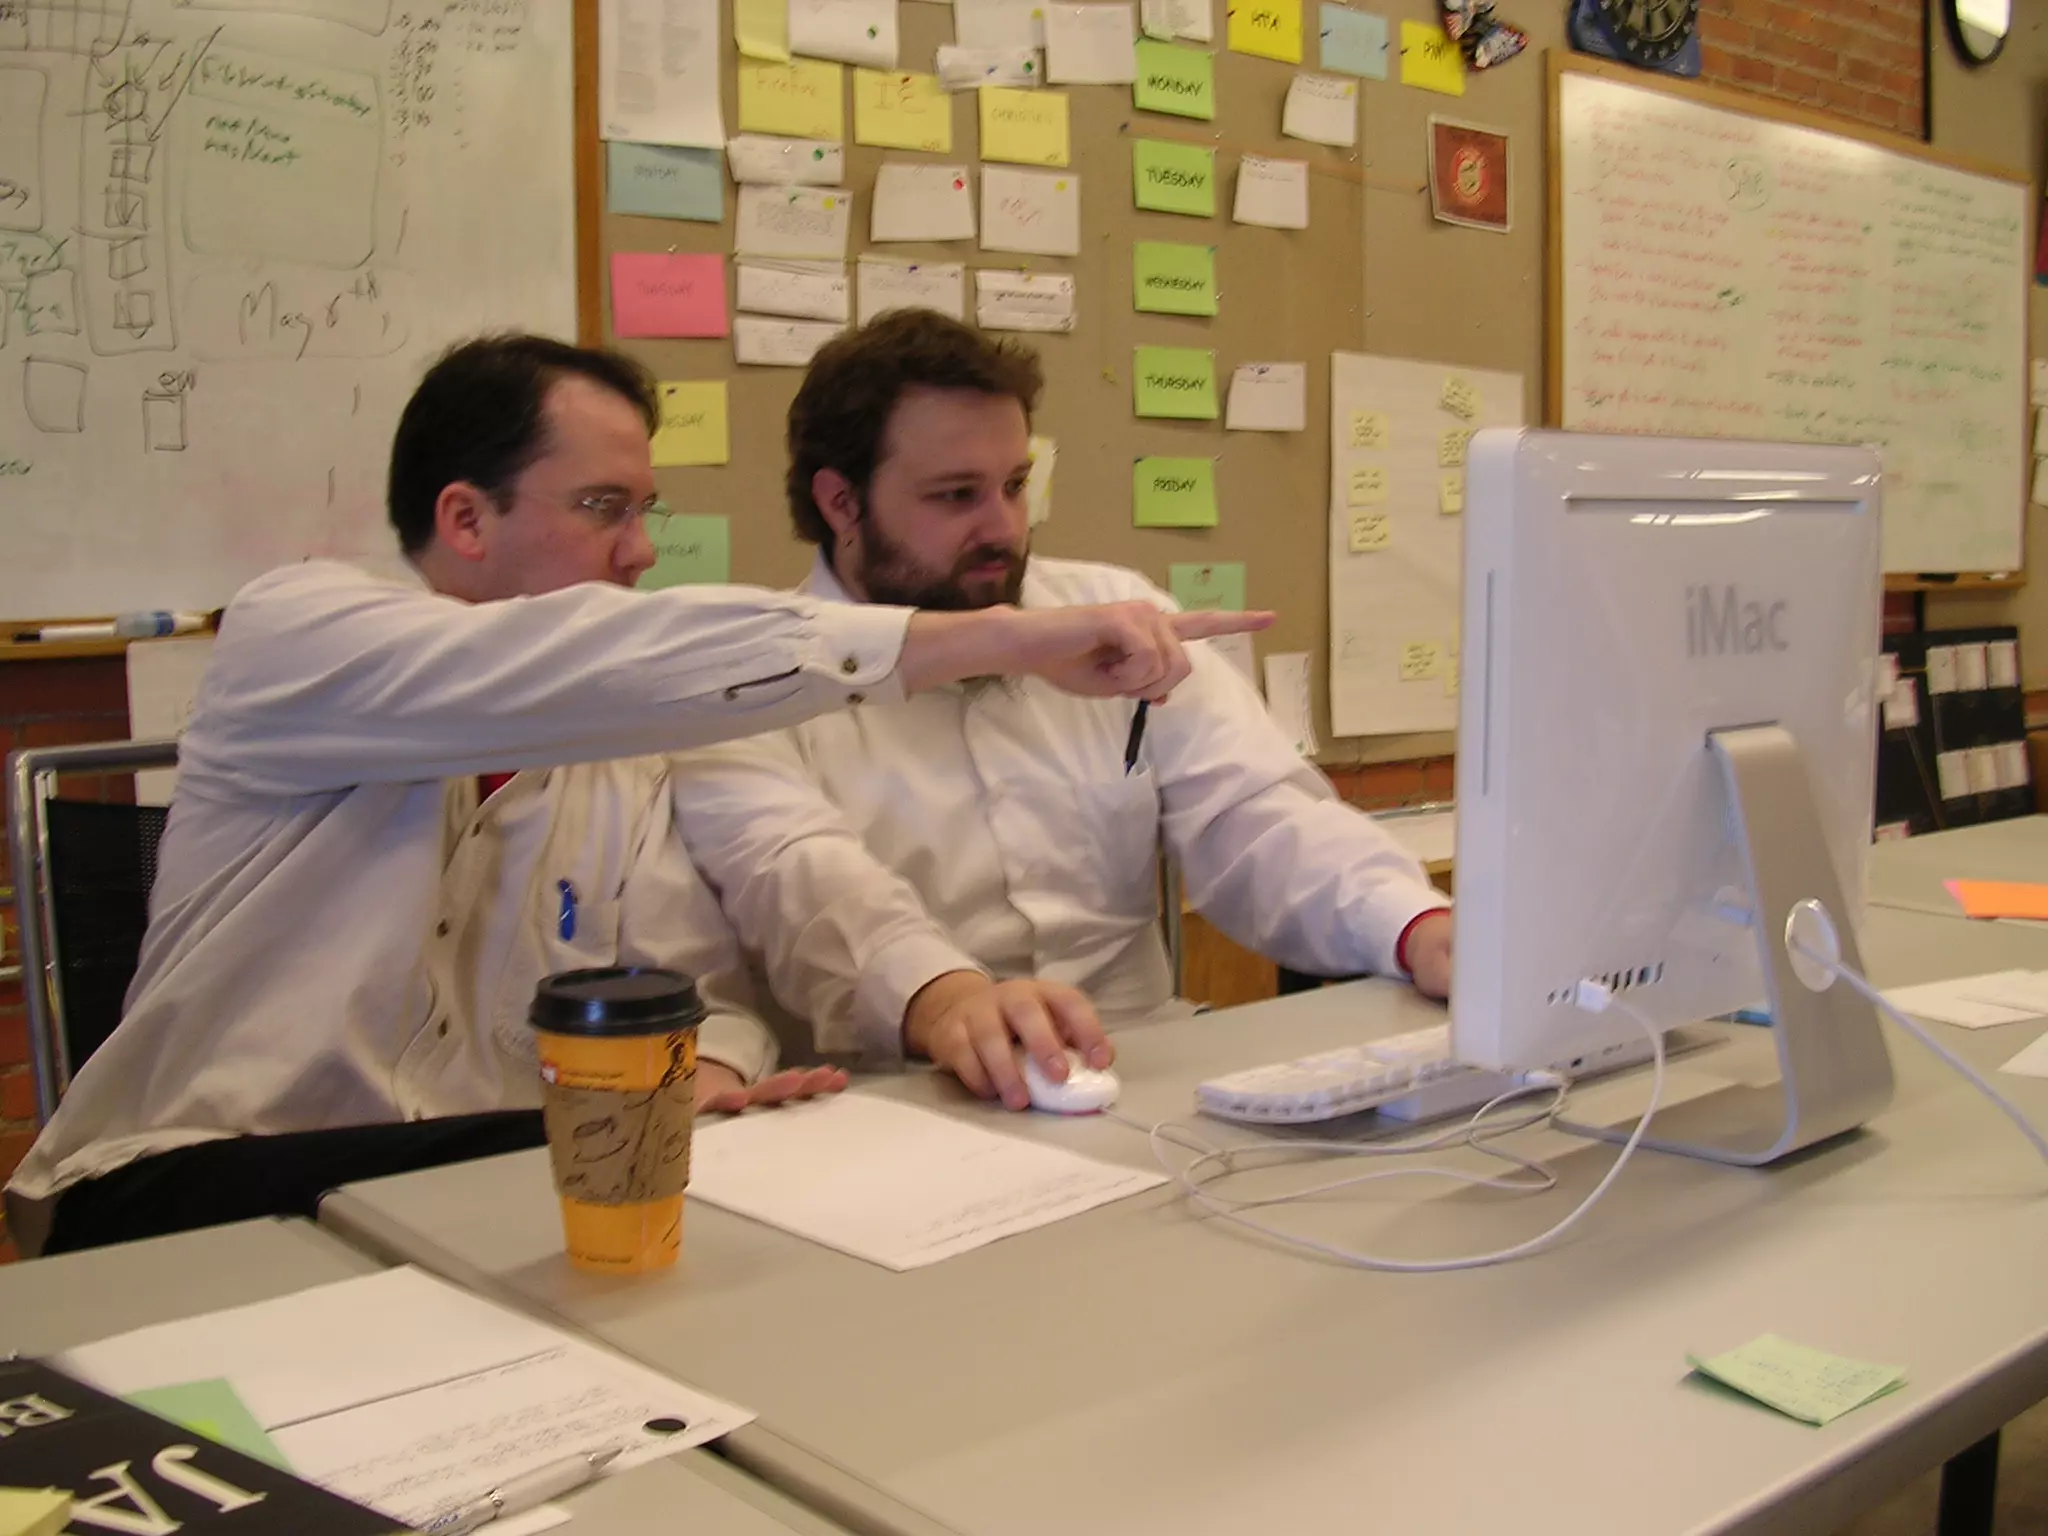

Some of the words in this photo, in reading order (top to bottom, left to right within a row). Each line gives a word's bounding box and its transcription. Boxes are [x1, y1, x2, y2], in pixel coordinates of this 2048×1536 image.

[1147, 72, 1204, 97] MONDAY
[1145, 167, 1206, 190] TUESDAY
[1144, 272, 1206, 292] WEDNESDAY
[238, 278, 314, 362] May
[1144, 373, 1207, 391] THURSDAY
[1152, 477, 1197, 493] FRIDAY
[1685, 582, 1790, 658] iMac
